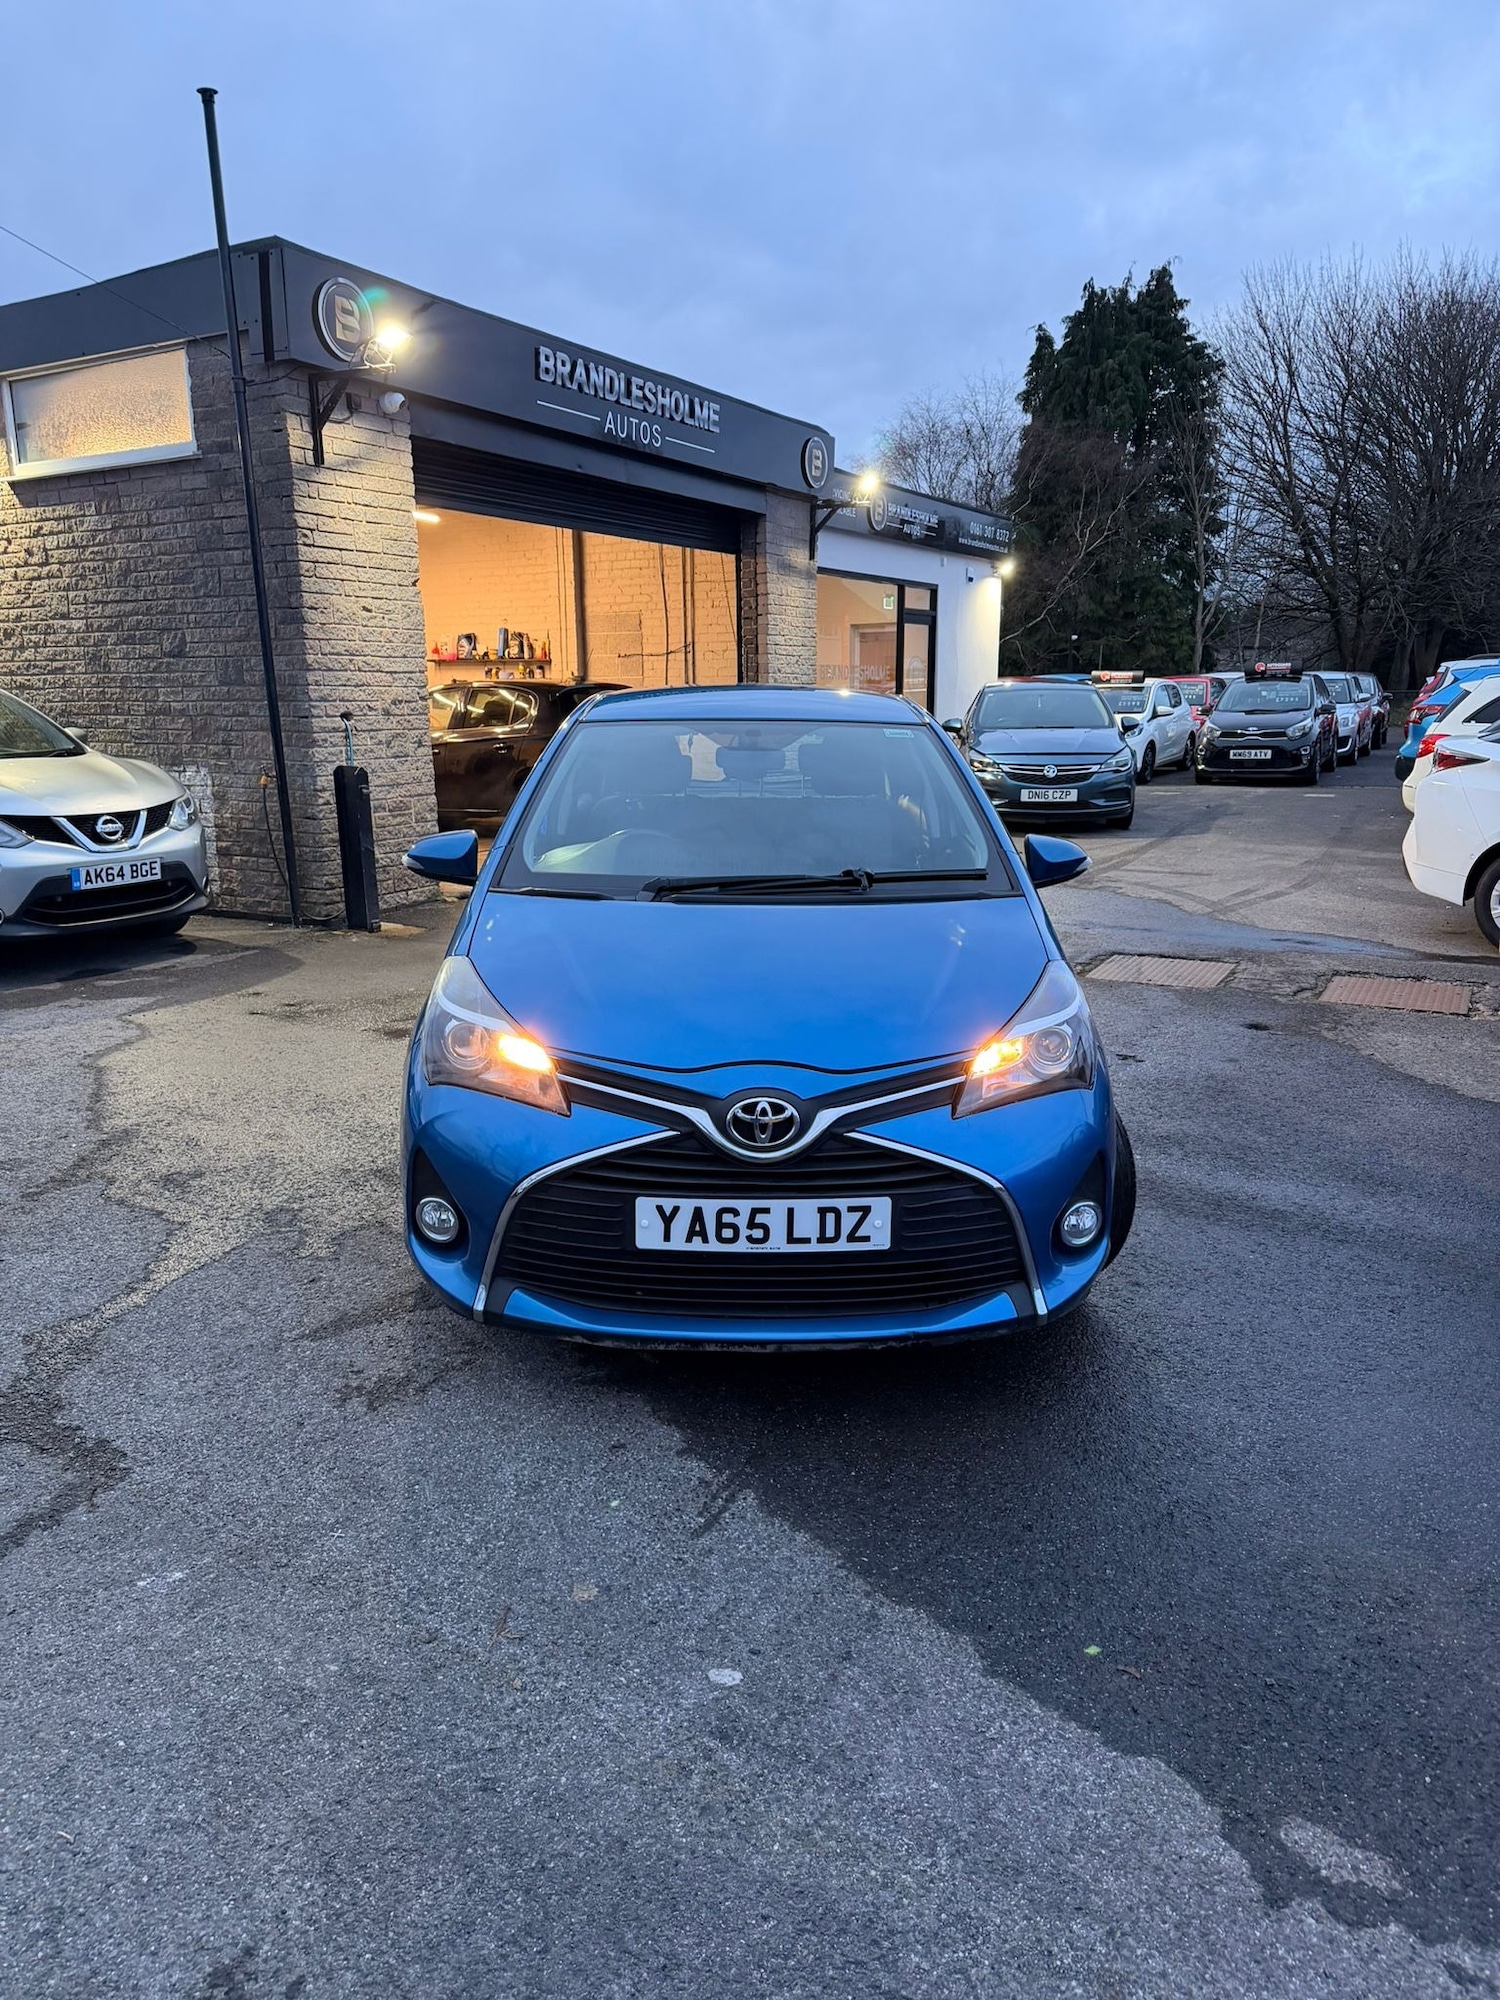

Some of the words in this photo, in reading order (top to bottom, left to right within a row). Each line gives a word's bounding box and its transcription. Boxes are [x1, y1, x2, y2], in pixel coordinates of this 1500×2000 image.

[537, 345, 721, 433] BRANDLESHOLME
[604, 411, 662, 448] AUTOS
[903, 522, 921, 537] AUTOS
[1028, 790, 1050, 800] DN16
[1051, 790, 1072, 800] CZP
[84, 865, 126, 886] AK64
[130, 861, 158, 879] BGE
[655, 1205, 772, 1245] YA65
[786, 1205, 872, 1245] LDZ
